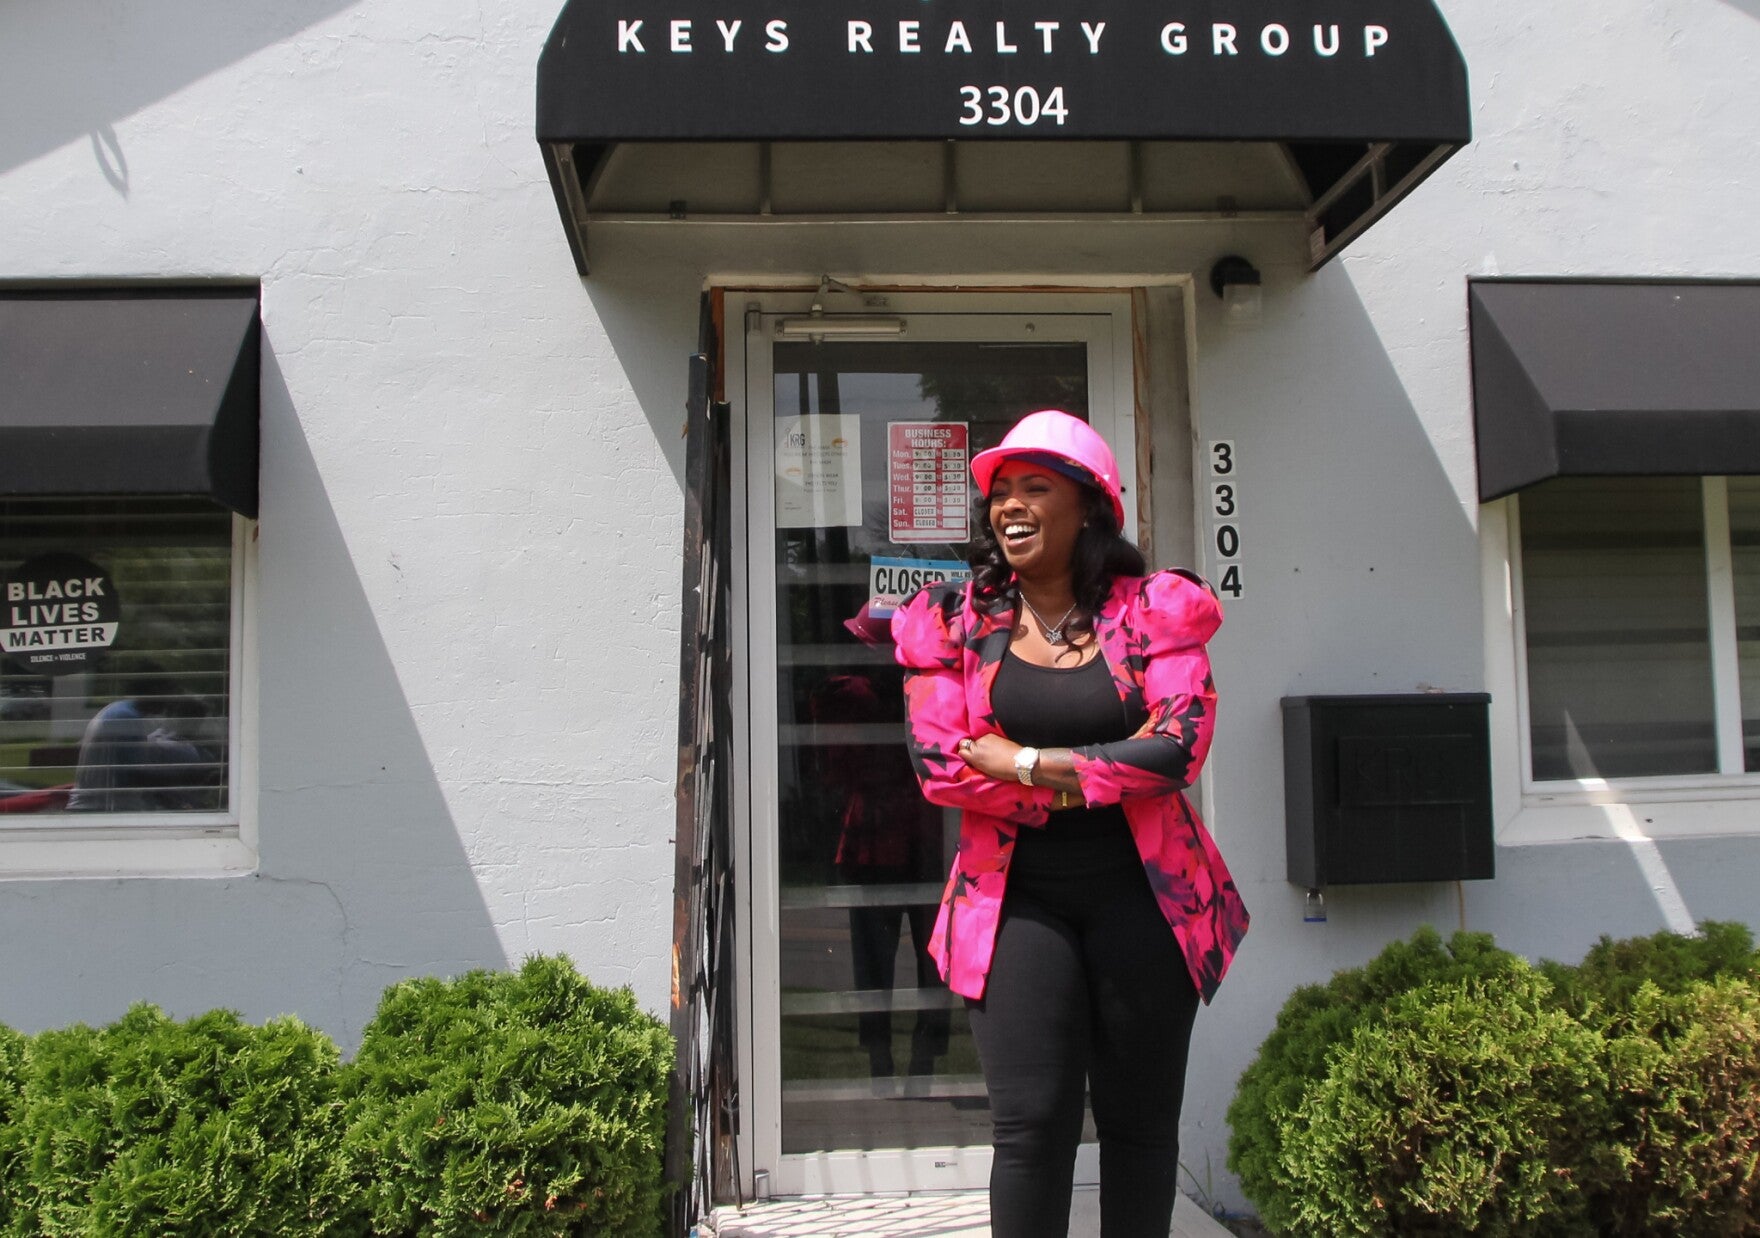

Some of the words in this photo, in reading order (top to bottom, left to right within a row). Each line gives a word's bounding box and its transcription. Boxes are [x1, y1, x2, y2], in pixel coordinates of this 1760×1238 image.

[619, 20, 789, 53] KEYS
[848, 21, 1106, 54] REALTY
[1161, 22, 1389, 57] GROUP
[960, 86, 1069, 126] 3304
[790, 433, 805, 446] KRG
[904, 429, 951, 438] BUSINESS
[911, 439, 947, 448] HOURS:
[893, 508, 908, 516] Sat.
[893, 520, 910, 528] Sun.
[8, 578, 104, 601] BLACK
[12, 602, 99, 626] LIVES
[9, 628, 105, 647] MATTER
[30, 655, 53, 663] SILENCE
[59, 653, 86, 661] VIOLENCE
